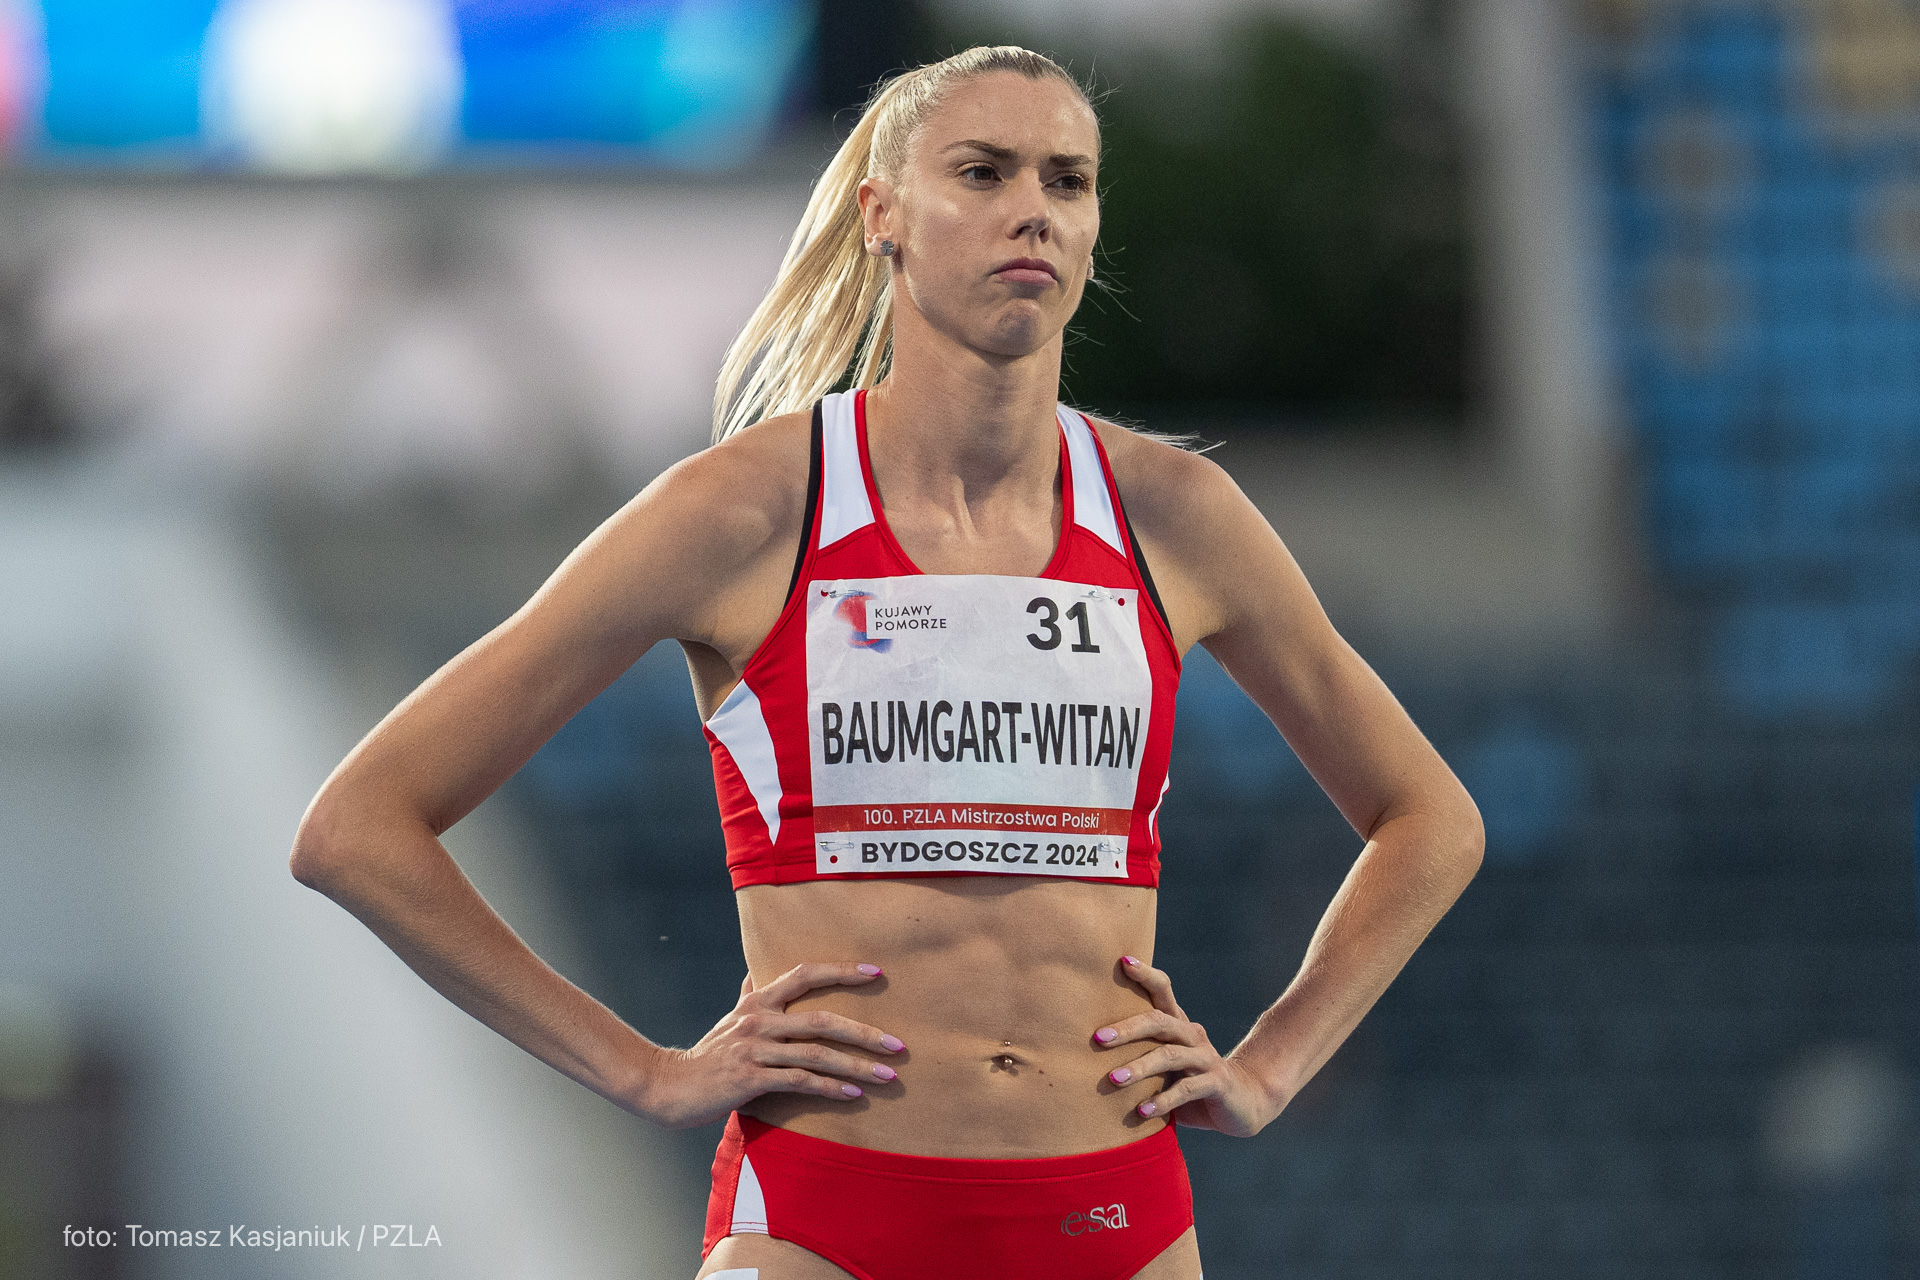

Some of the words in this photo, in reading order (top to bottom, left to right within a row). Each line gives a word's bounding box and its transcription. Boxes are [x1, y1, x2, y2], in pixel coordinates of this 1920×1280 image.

[875, 605, 933, 619] KUJAWY
[875, 618, 947, 631] POMORZE
[1025, 597, 1101, 654] 31
[821, 700, 1141, 770] BAUMGART-WITAN
[863, 809, 898, 826] 100.
[903, 808, 946, 825] PZLA
[951, 808, 1058, 827] Mistrzostwa
[1061, 812, 1100, 830] Polski
[861, 840, 1040, 865] BYDGOSZCZ
[1045, 843, 1099, 867] 2024
